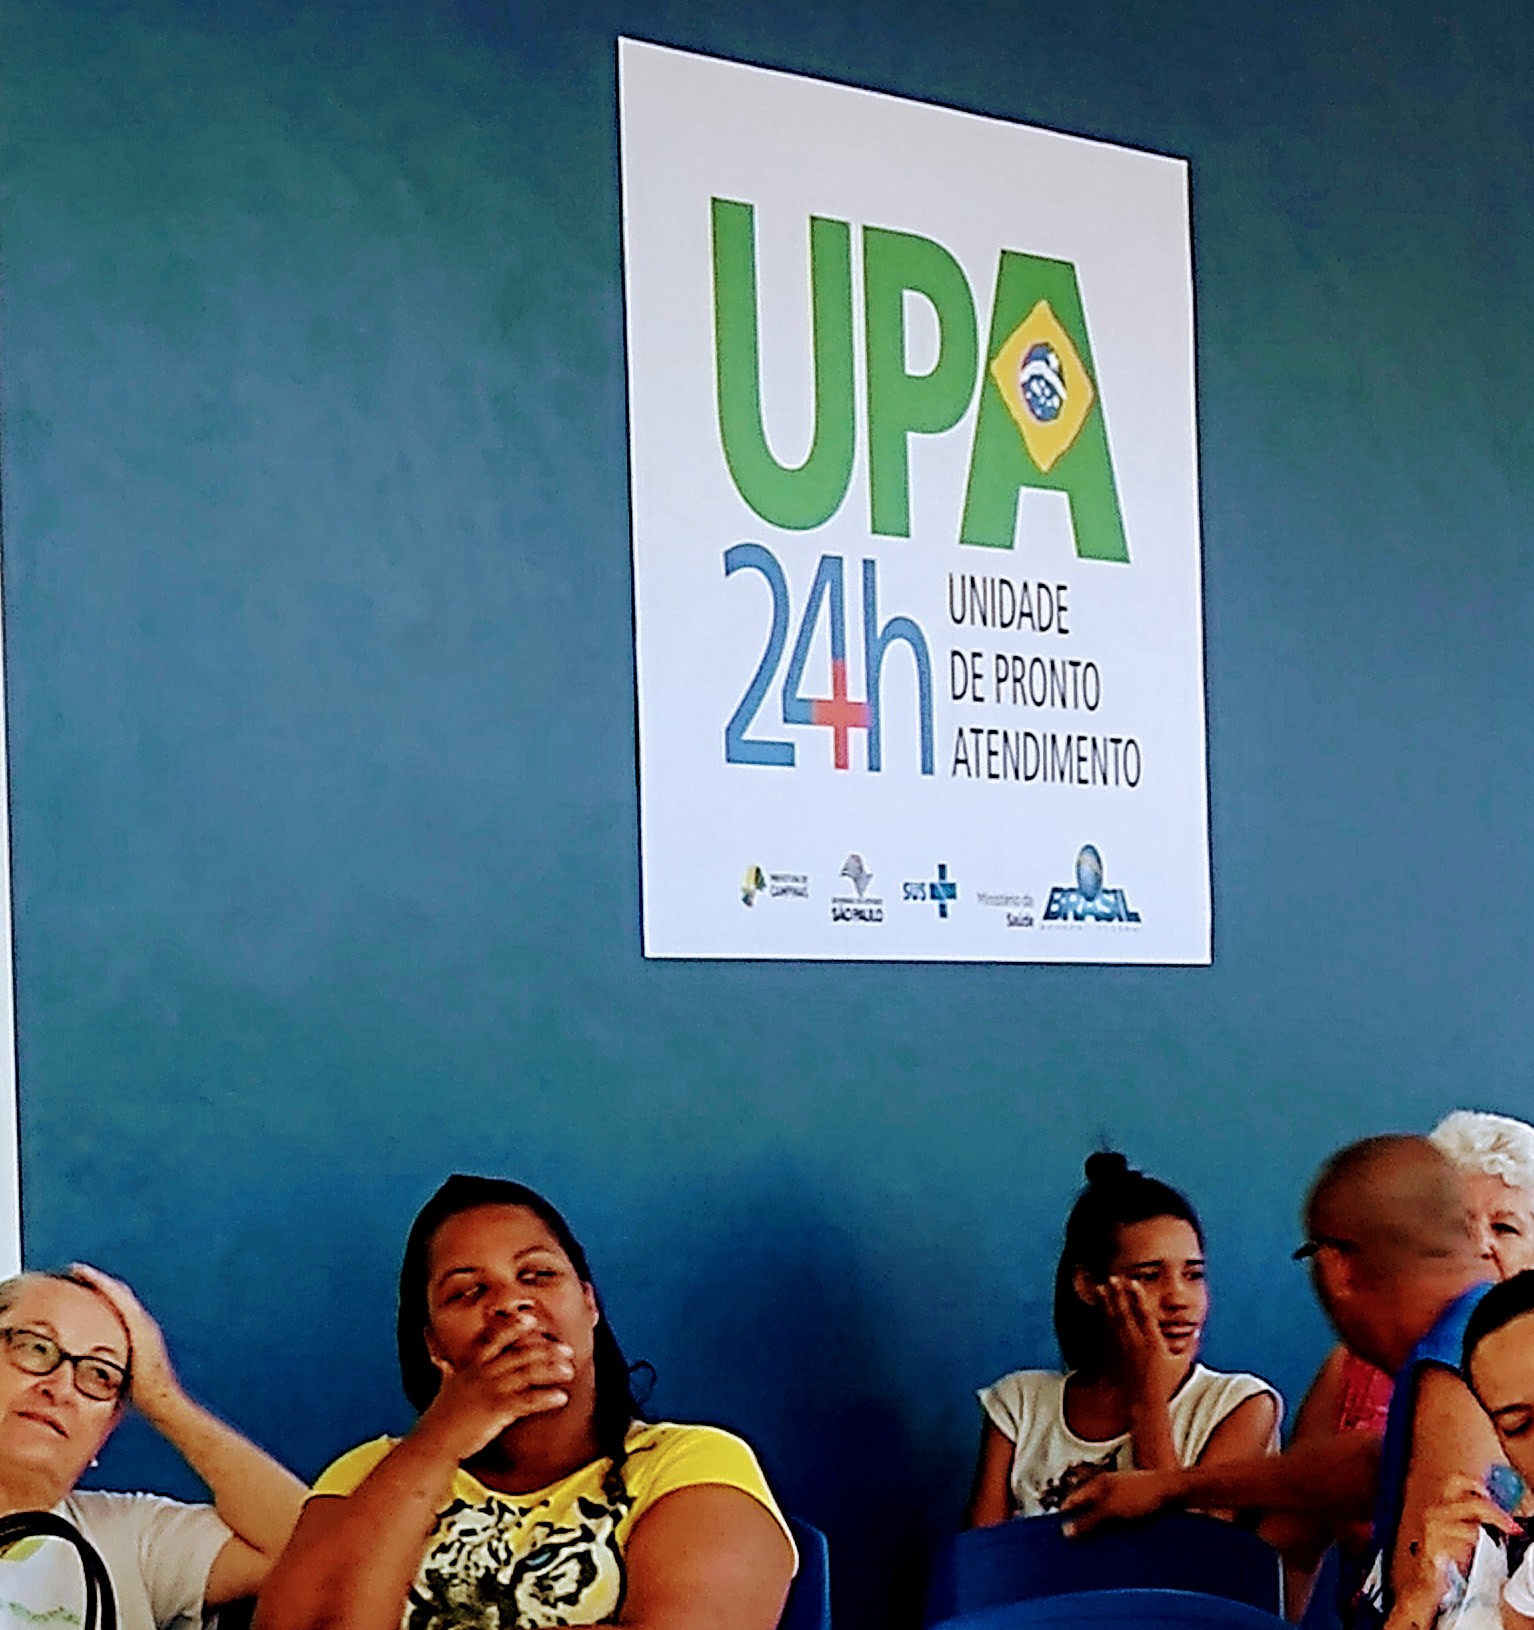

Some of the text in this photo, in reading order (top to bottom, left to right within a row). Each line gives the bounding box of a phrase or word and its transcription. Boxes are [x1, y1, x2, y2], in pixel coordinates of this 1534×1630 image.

[710, 197, 1130, 563] UPA
[947, 572, 1070, 636] UNIDADE
[724, 543, 935, 776] 24h
[950, 649, 1101, 713] DE PRONTO
[951, 727, 1142, 789] ATENDIMENTO
[1042, 886, 1142, 922] BRASIL
